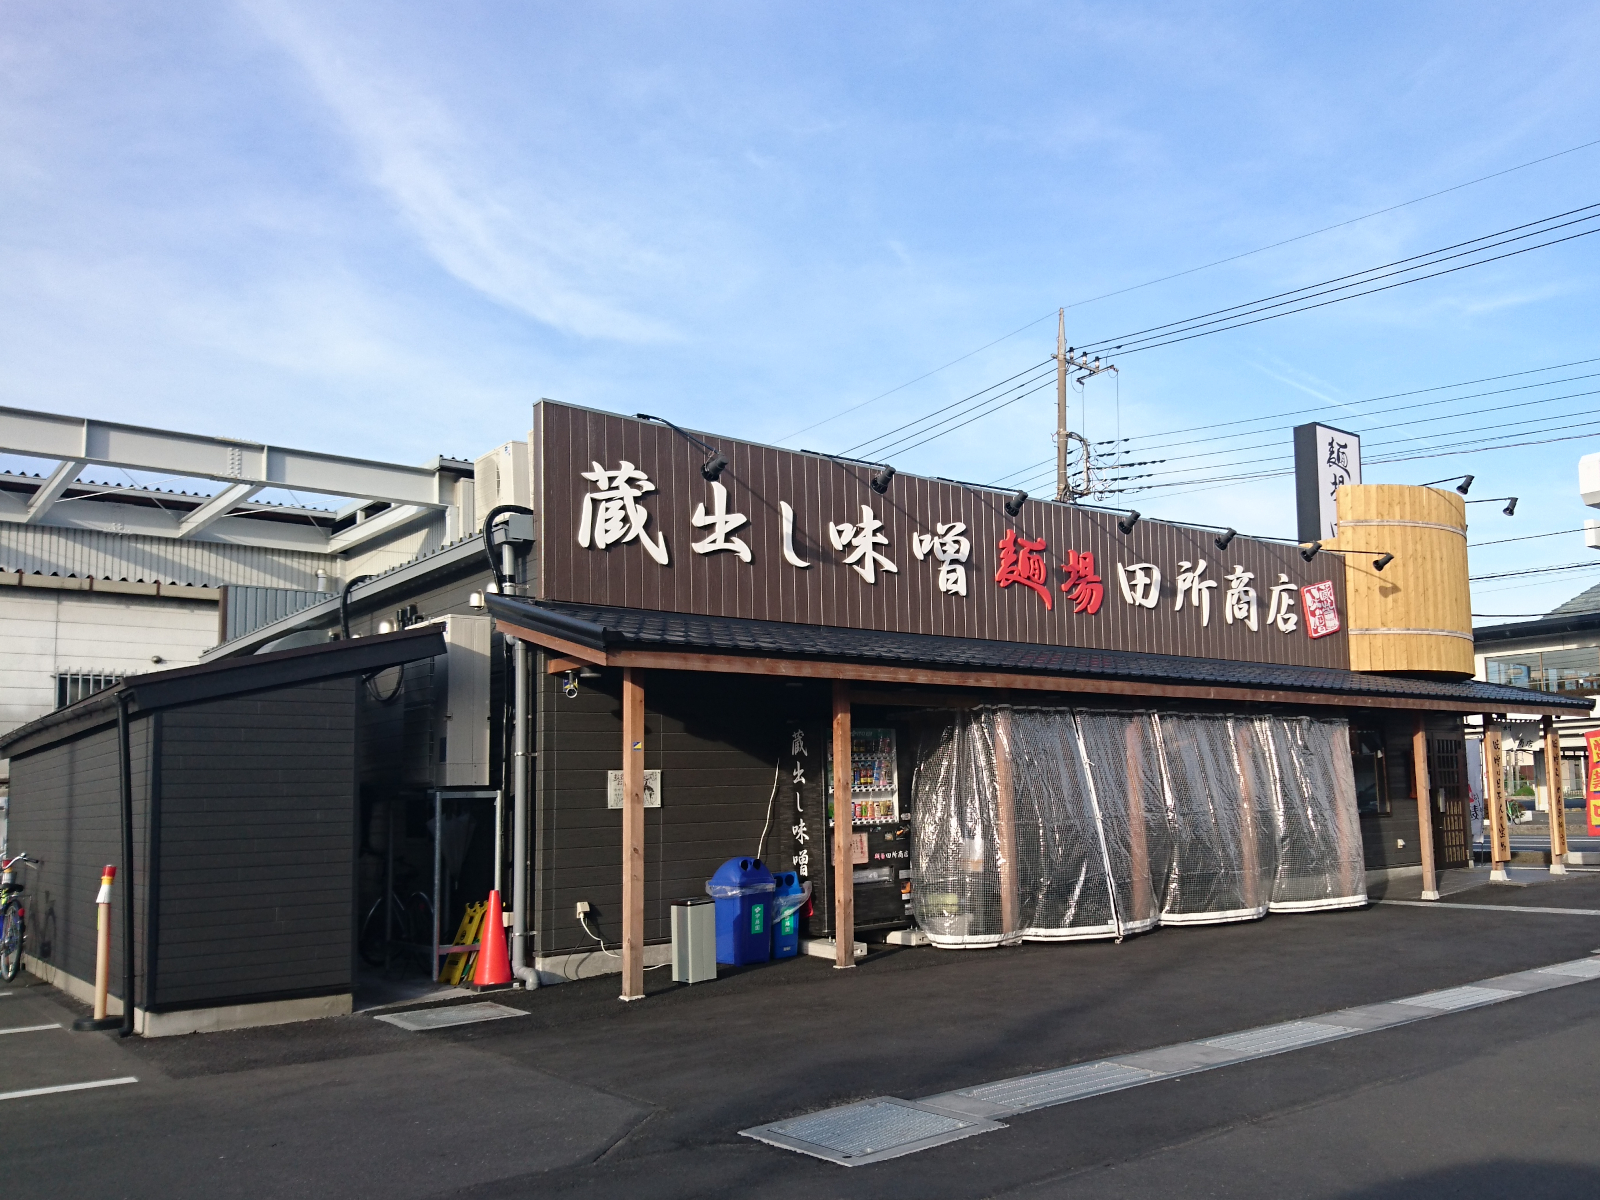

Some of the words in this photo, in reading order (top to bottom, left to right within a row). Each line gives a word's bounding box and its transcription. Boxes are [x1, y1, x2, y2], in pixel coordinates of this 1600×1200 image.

[791, 728, 810, 878] 蔵出し味噌
